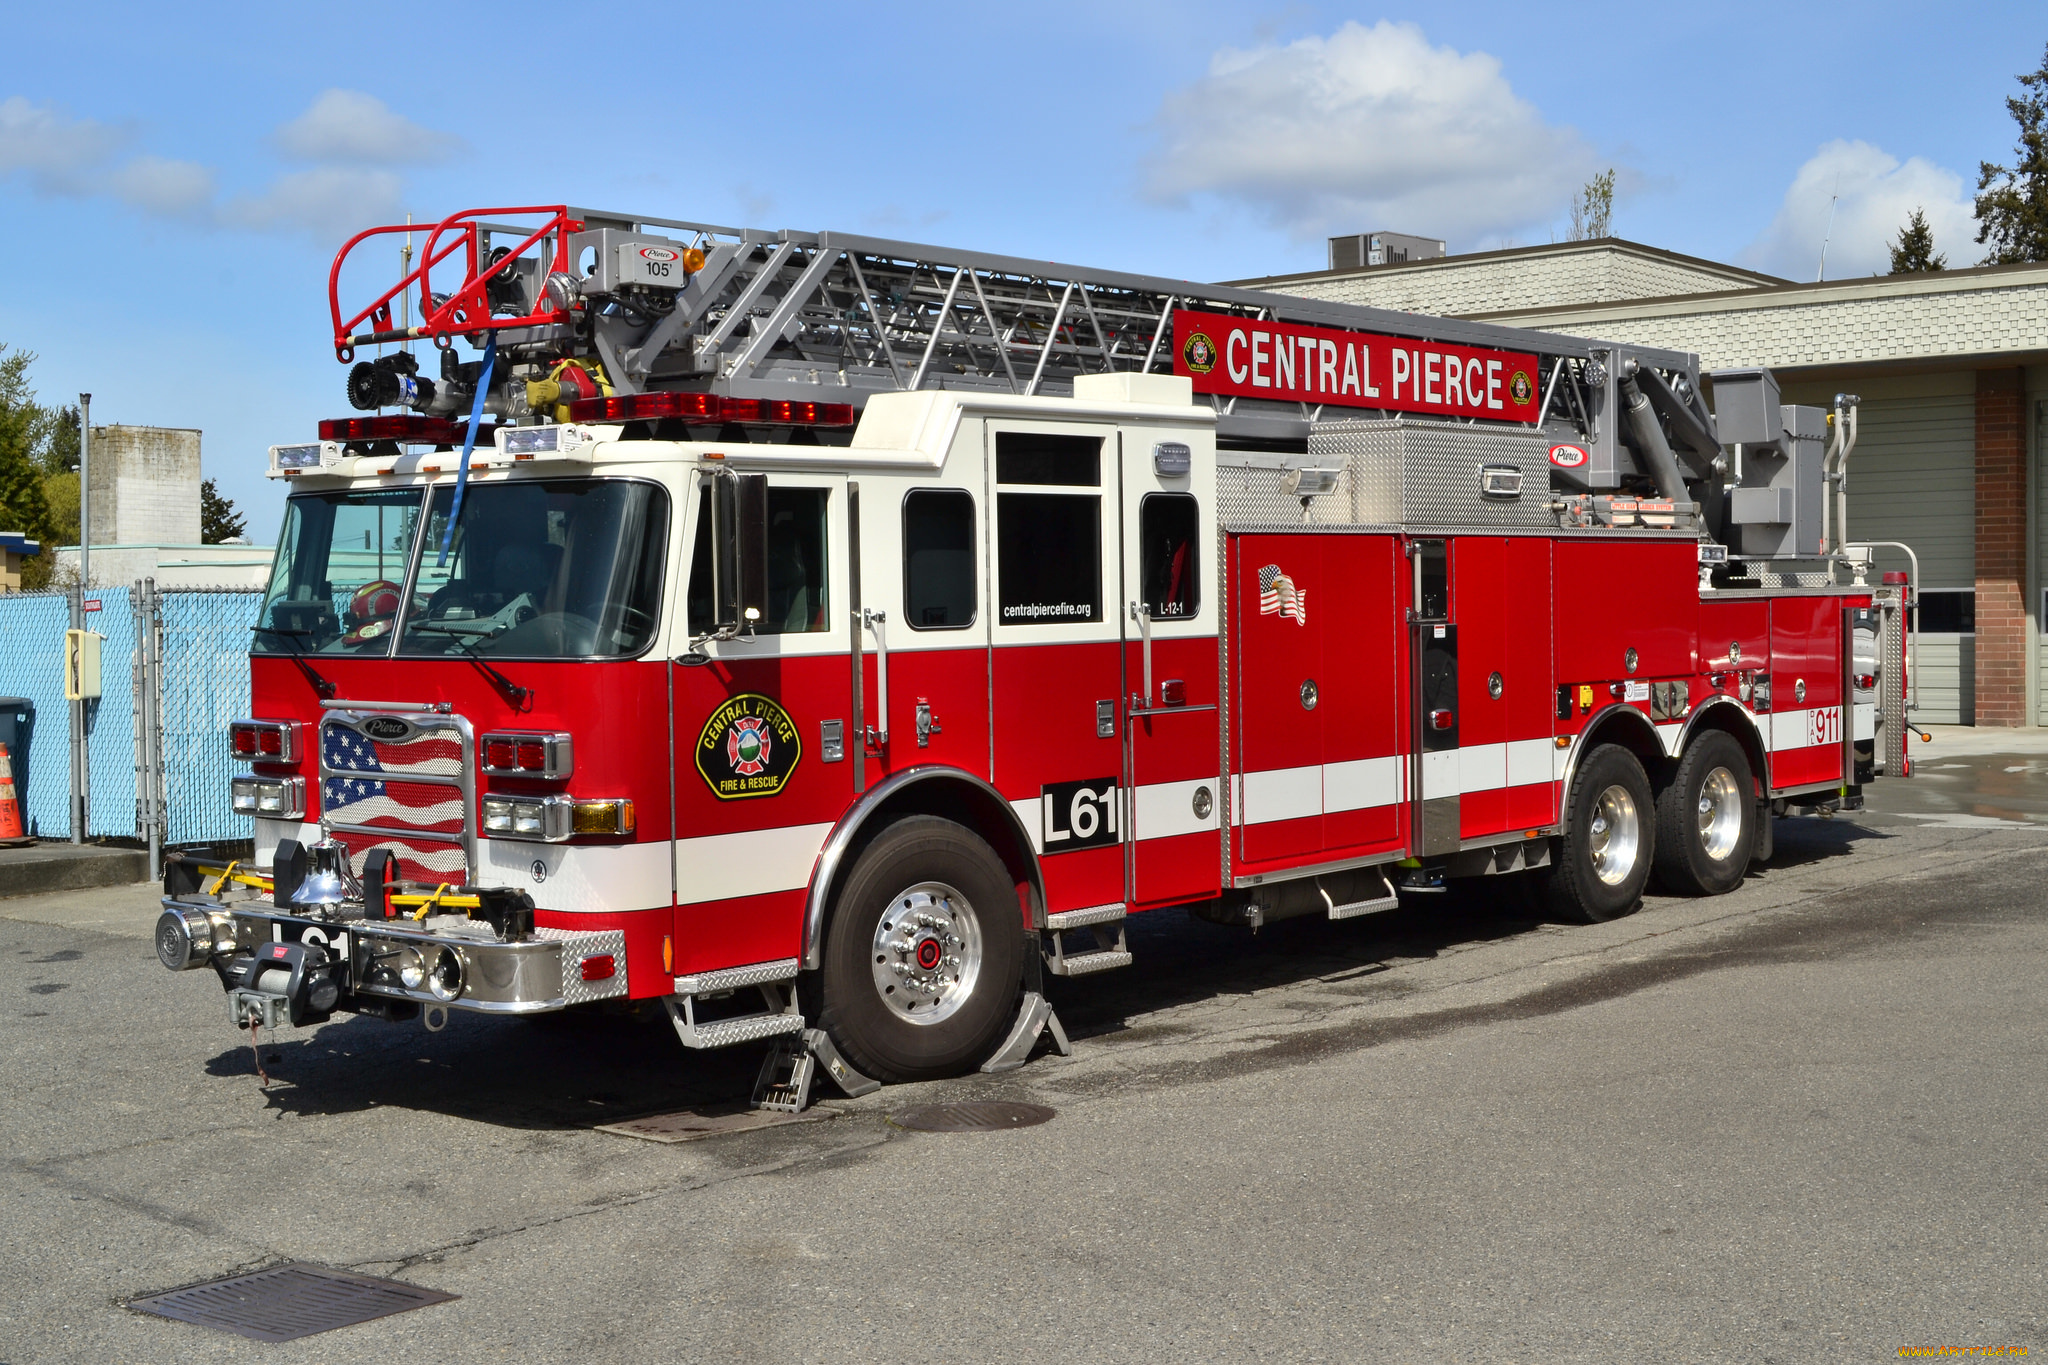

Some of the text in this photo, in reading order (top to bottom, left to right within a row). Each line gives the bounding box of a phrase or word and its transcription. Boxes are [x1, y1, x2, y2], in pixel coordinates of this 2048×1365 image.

[647, 249, 670, 258] Pierce
[646, 262, 672, 277] 105'
[1226, 328, 1503, 410] CENTRAL PIERCE
[1556, 447, 1579, 462] Pierce
[1004, 602, 1091, 619] centralpiercefire.org
[1160, 602, 1183, 615] L-12-1
[370, 719, 403, 734] Pierce
[704, 700, 793, 750] CENTRAL PIERCE
[1816, 707, 1839, 743] 911
[746, 764, 752, 772] 6
[720, 775, 779, 791] FIRE & RESCUE
[1044, 786, 1116, 843] L61
